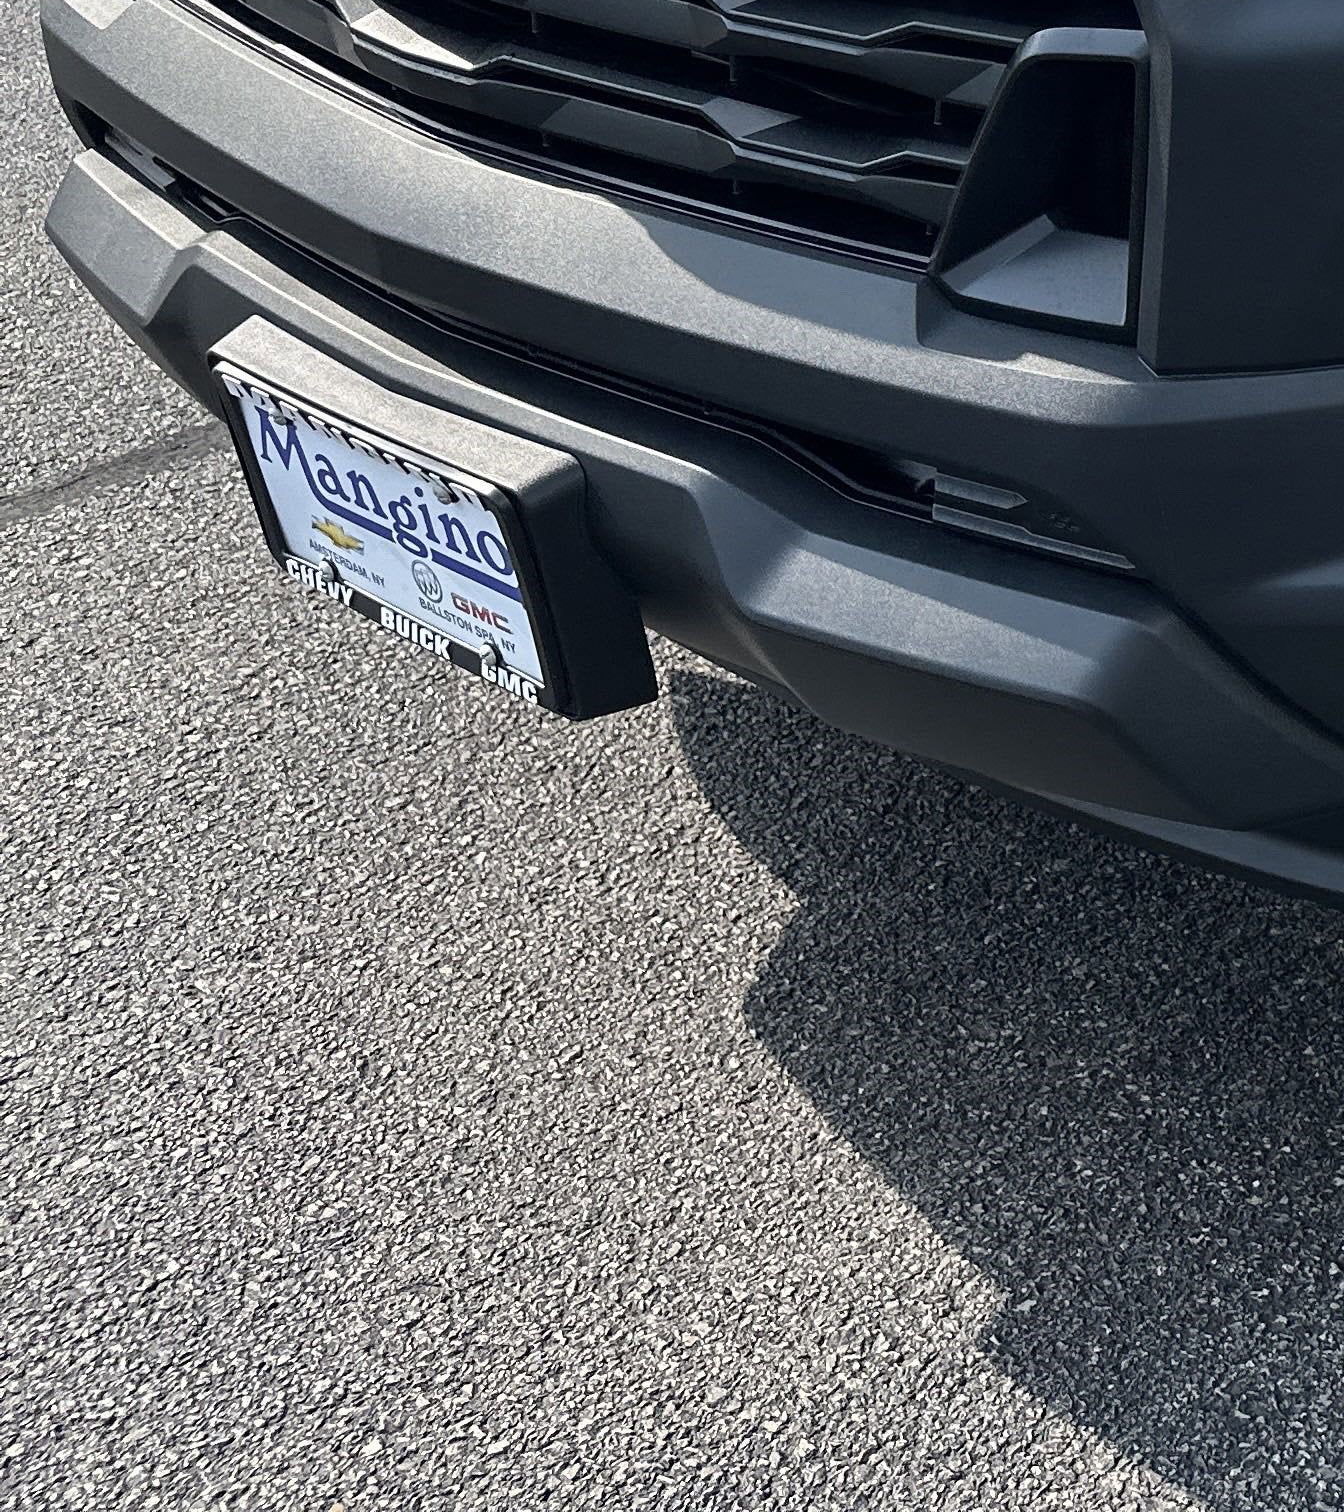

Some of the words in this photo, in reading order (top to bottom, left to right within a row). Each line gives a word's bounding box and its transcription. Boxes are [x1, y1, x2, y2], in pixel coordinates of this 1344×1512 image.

[256, 405, 515, 577] Mangino
[286, 558, 354, 607] CHEVY
[371, 571, 385, 588] NY
[380, 606, 451, 660] BUICK
[419, 596, 473, 634] BALLSTON
[501, 637, 516, 654] NY
[451, 593, 515, 635] GMC
[481, 659, 538, 705] GMC
